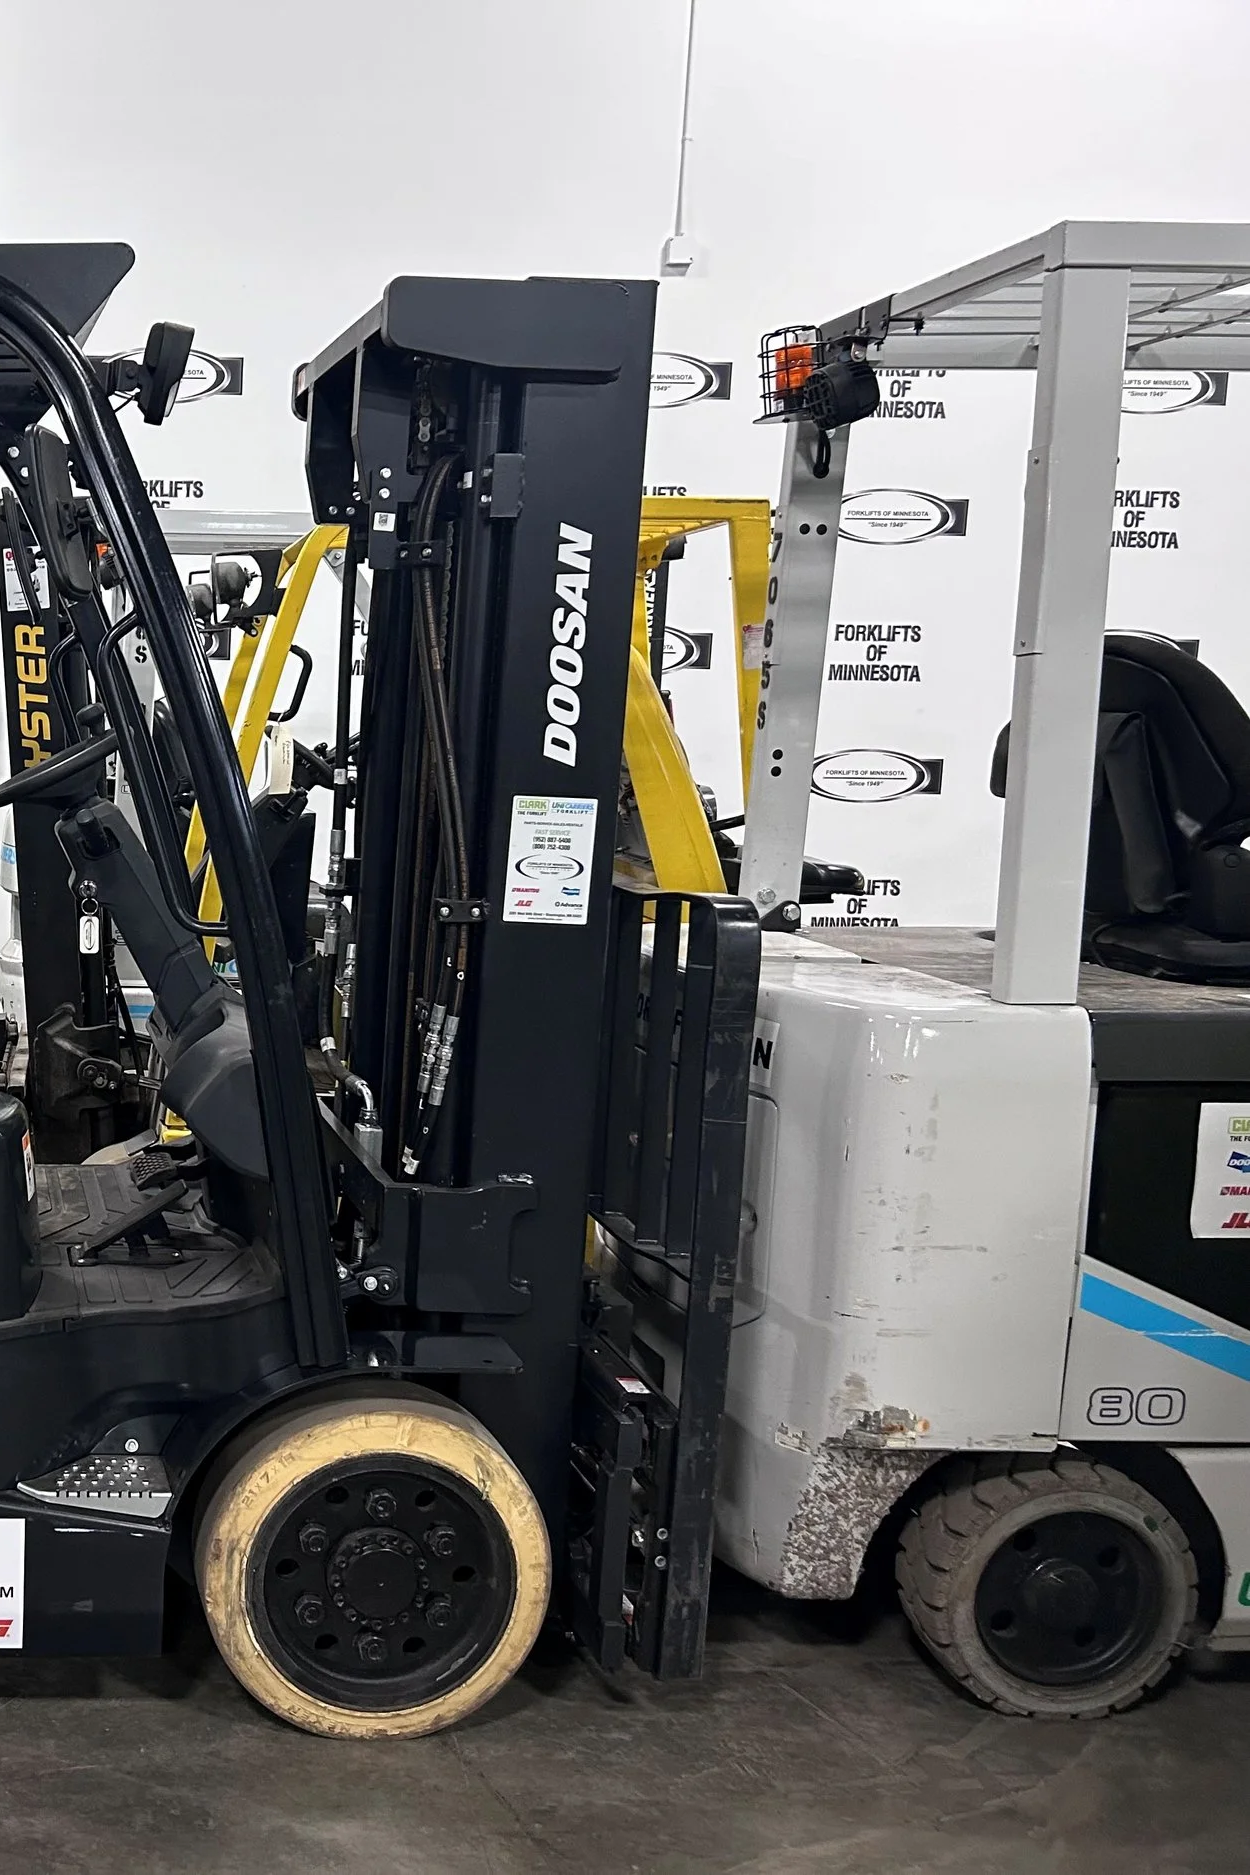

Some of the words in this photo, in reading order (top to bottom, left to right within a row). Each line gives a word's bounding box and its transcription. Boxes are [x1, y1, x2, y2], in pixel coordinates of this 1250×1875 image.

[890, 379, 912, 398] OF
[1153, 379, 1189, 387] MINNESOTA
[870, 400, 946, 419] NNESOTA
[1114, 490, 1180, 509] RKLIFTS
[1123, 510, 1146, 528] OF
[834, 624, 922, 643] FORKLIFTS
[543, 522, 593, 767] DOOSAN
[866, 644, 888, 662] OF
[828, 664, 921, 682] MINNESOTA
[15, 624, 52, 769] YSTER
[519, 800, 547, 810] CLARK
[846, 898, 867, 915] OF
[1086, 1387, 1187, 1426] 80
